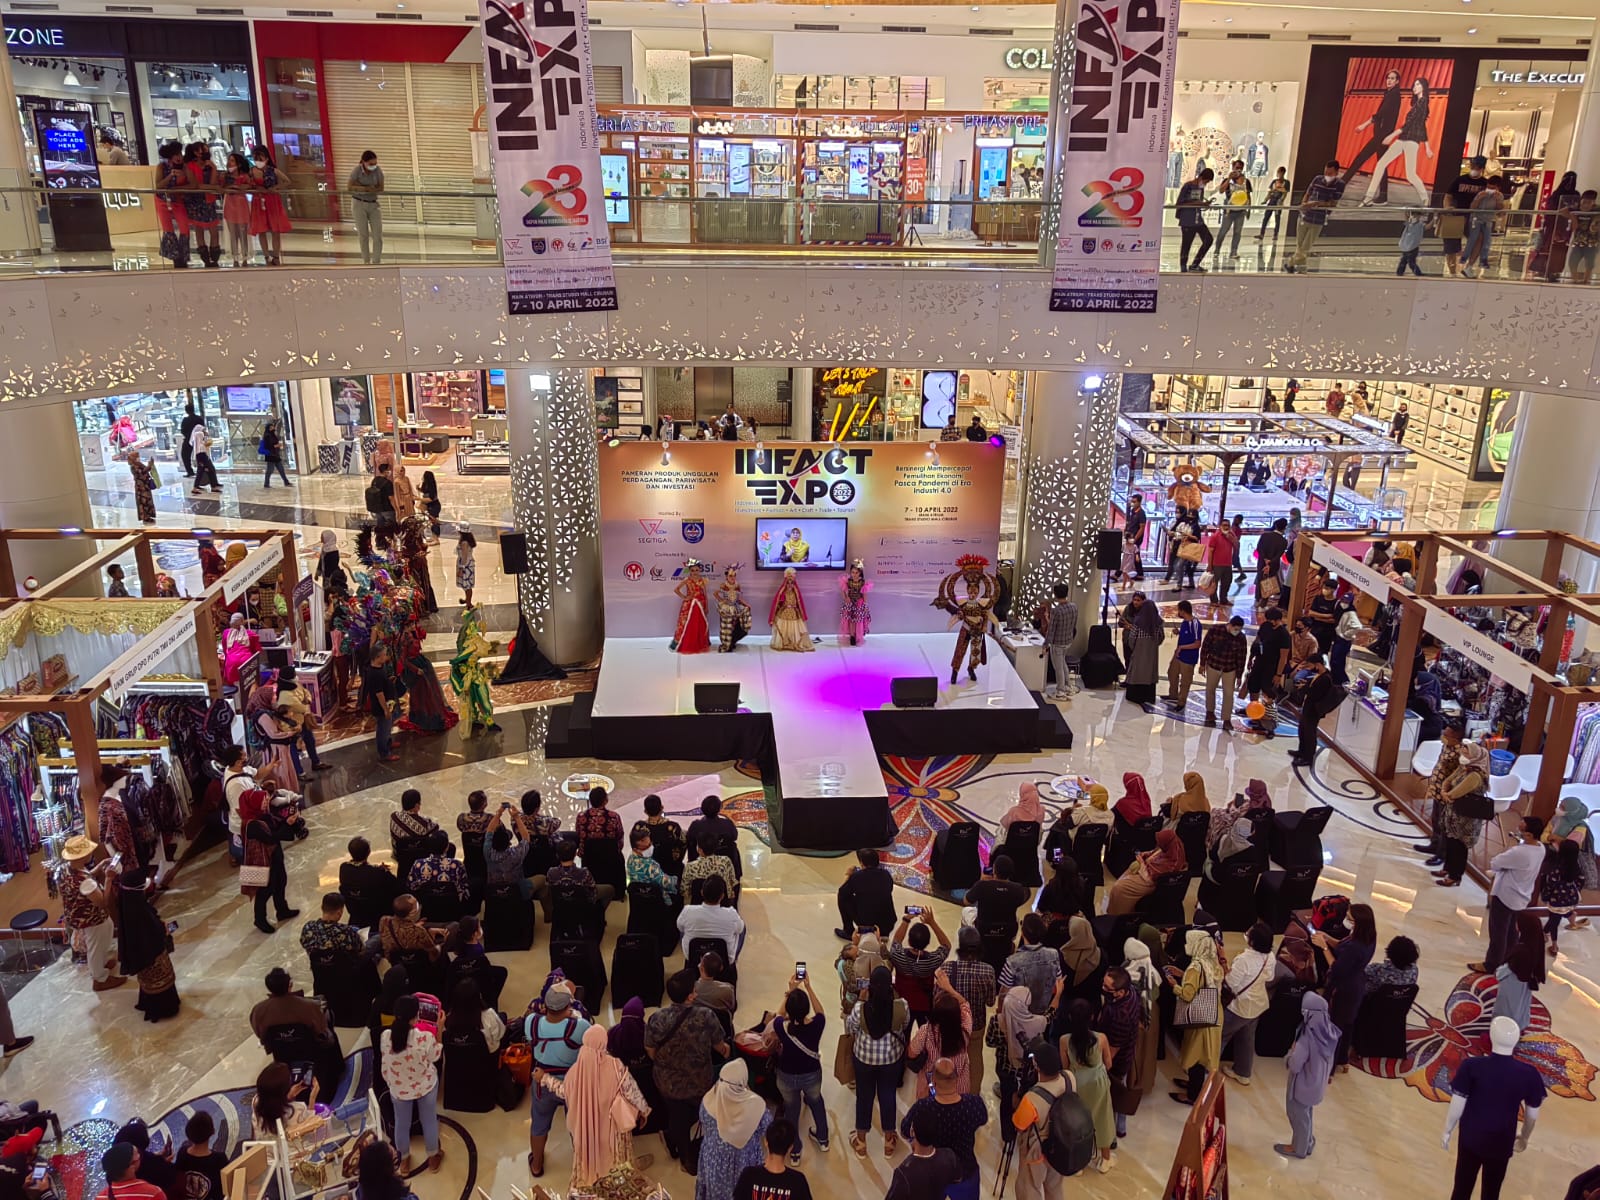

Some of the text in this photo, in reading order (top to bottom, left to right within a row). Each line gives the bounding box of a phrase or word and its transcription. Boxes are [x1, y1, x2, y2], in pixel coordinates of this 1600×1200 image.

[4, 27, 64, 45] ZONE
[586, 63, 594, 96] Fashion
[1158, 108, 1168, 153] Investment
[1163, 69, 1171, 101] Fashion
[1168, 18, 1176, 39] Craft
[579, 110, 588, 149] Indonesia
[589, 104, 599, 149] Investment
[1147, 114, 1157, 153] Indonesia
[512, 302, 520, 311] 7
[530, 301, 544, 310] 10
[547, 299, 582, 310] APRIL
[585, 298, 614, 308] 2022
[1054, 299, 1060, 307] 7
[1070, 299, 1084, 308] 10
[1086, 300, 1122, 308] APRIL
[1124, 300, 1154, 309] 2022
[735, 448, 873, 477] INFACT
[747, 480, 856, 506] EXPO
[124, 666, 138, 682] GRUP
[147, 648, 160, 663] PUTRI
[176, 620, 194, 640] JAKARTA
[1462, 640, 1496, 664] VIP LOUNGE
